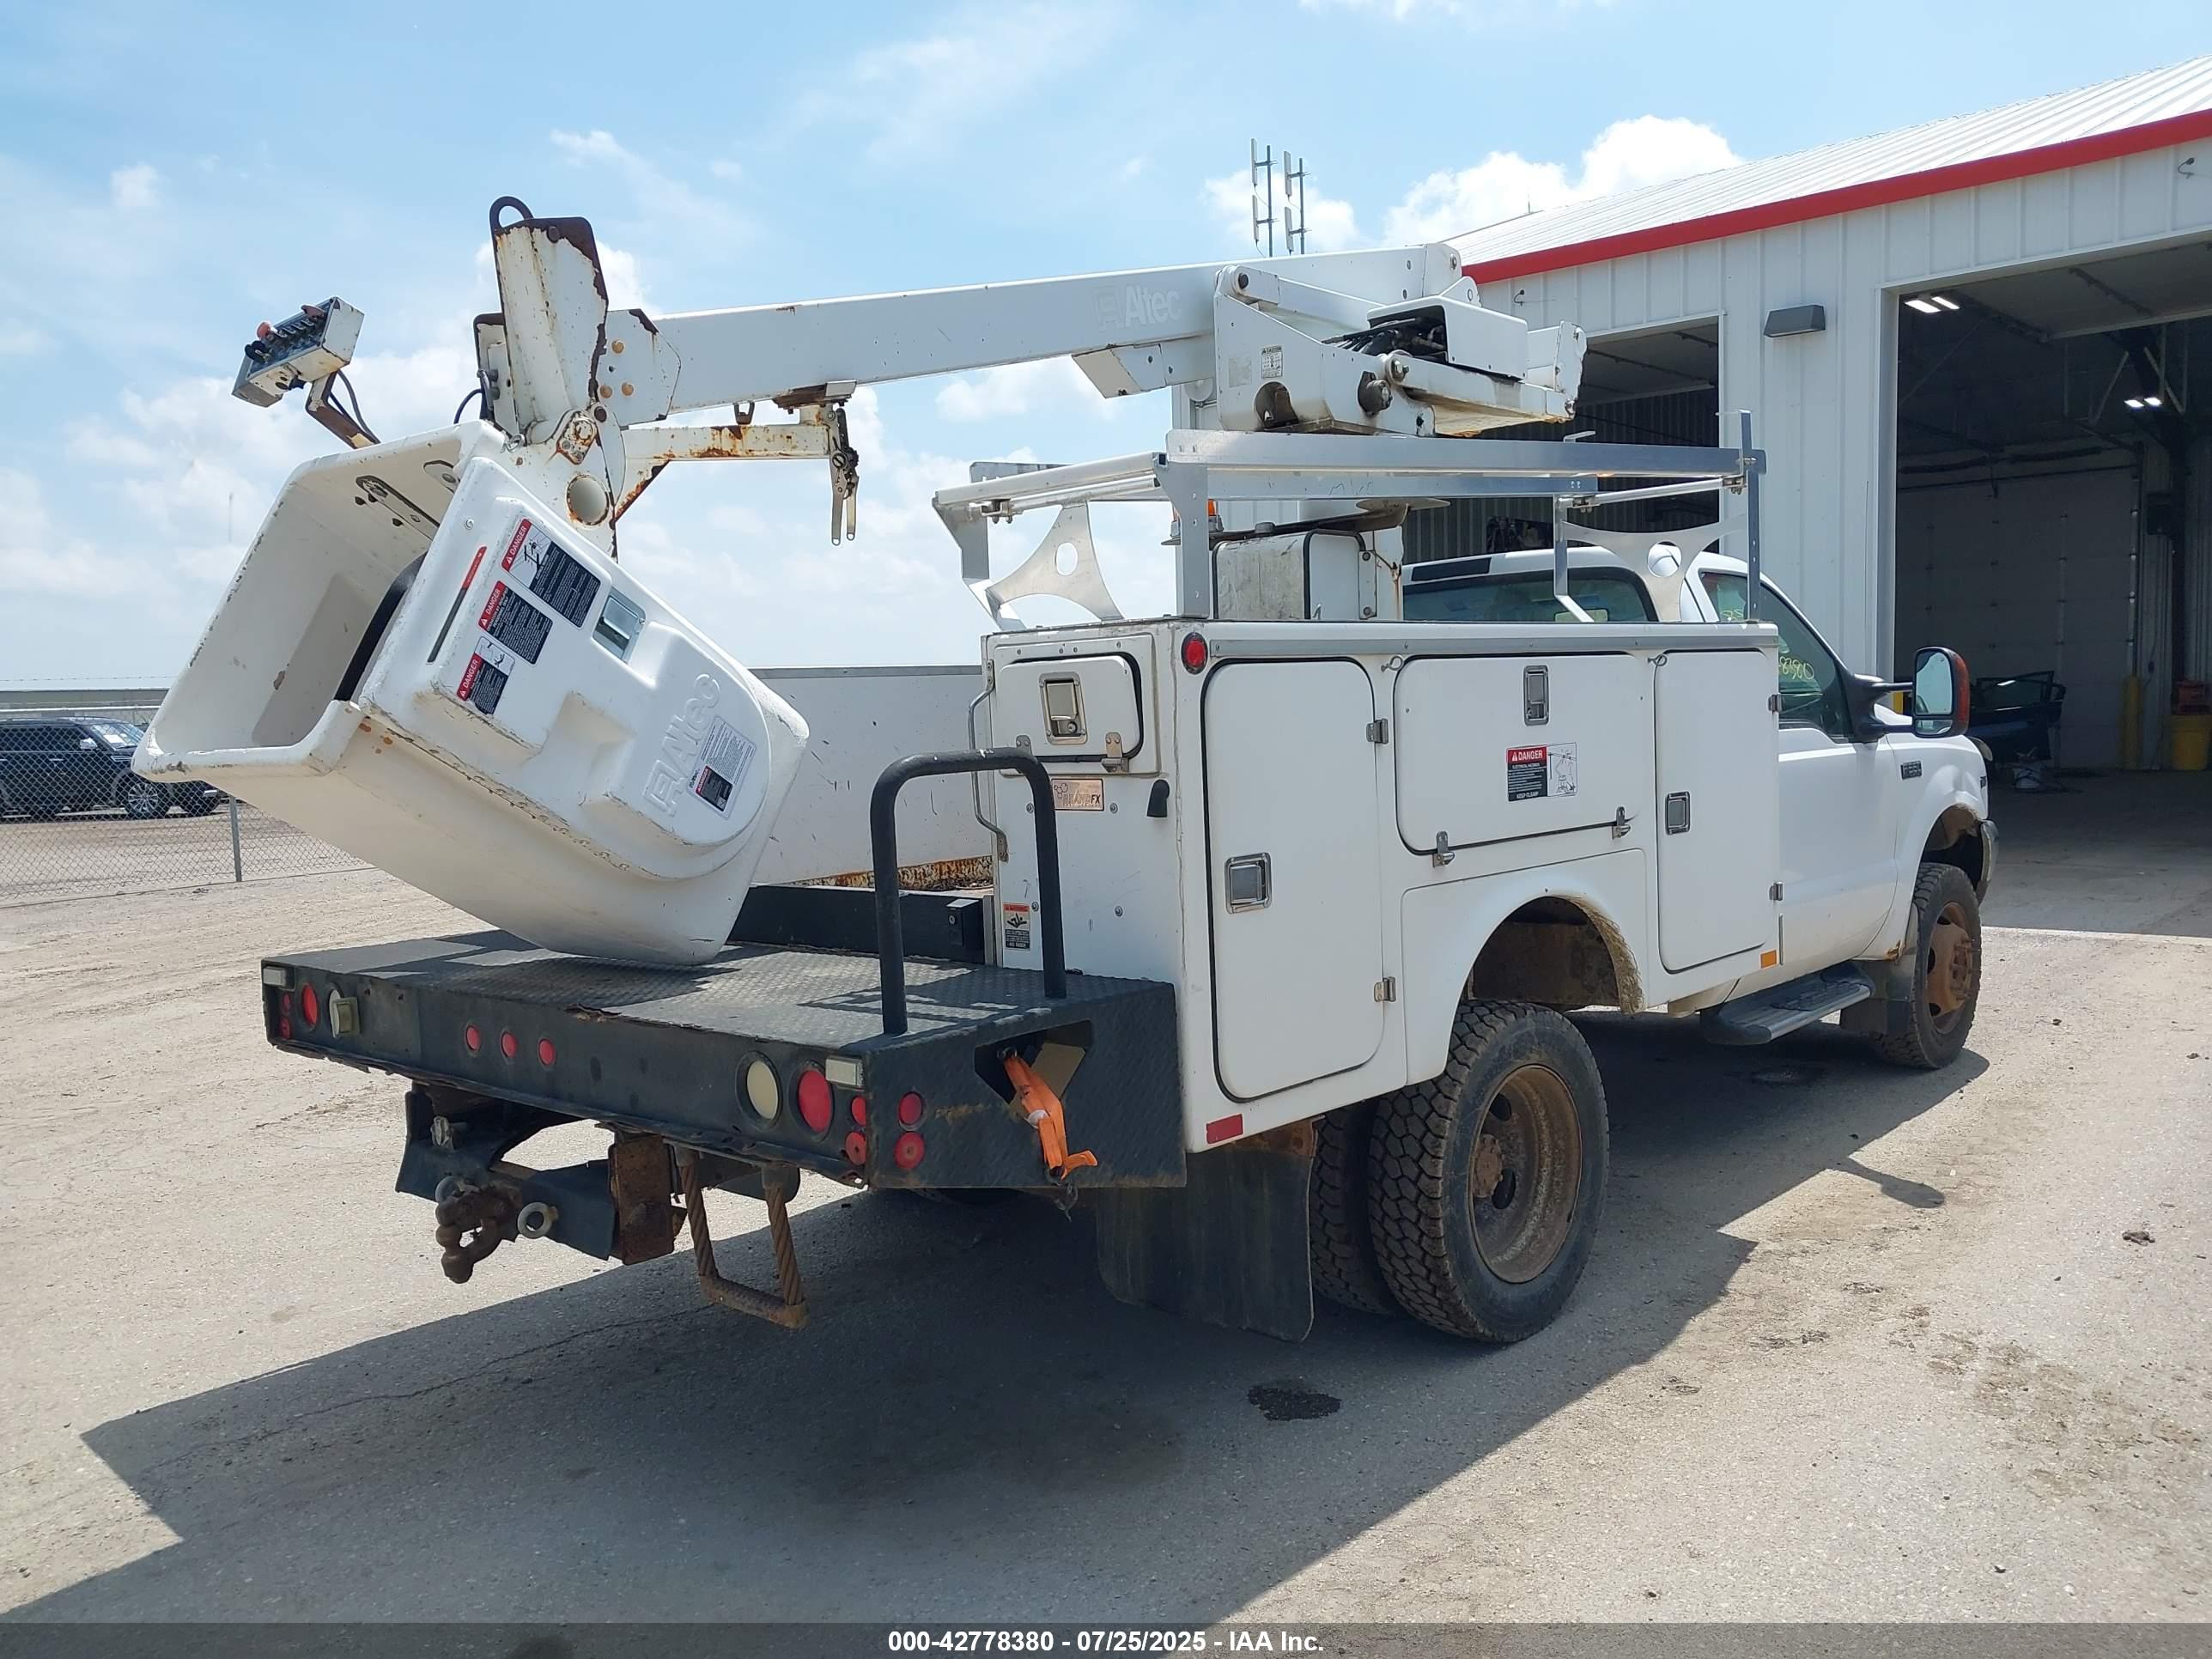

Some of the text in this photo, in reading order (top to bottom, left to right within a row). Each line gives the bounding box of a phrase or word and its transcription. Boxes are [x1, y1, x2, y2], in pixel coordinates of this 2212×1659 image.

[1126, 285, 1182, 327] Altec
[509, 526, 527, 555] DANGER
[485, 588, 501, 615] DANGER
[462, 659, 478, 688] DANGER
[1518, 750, 1543, 761] DANGER
